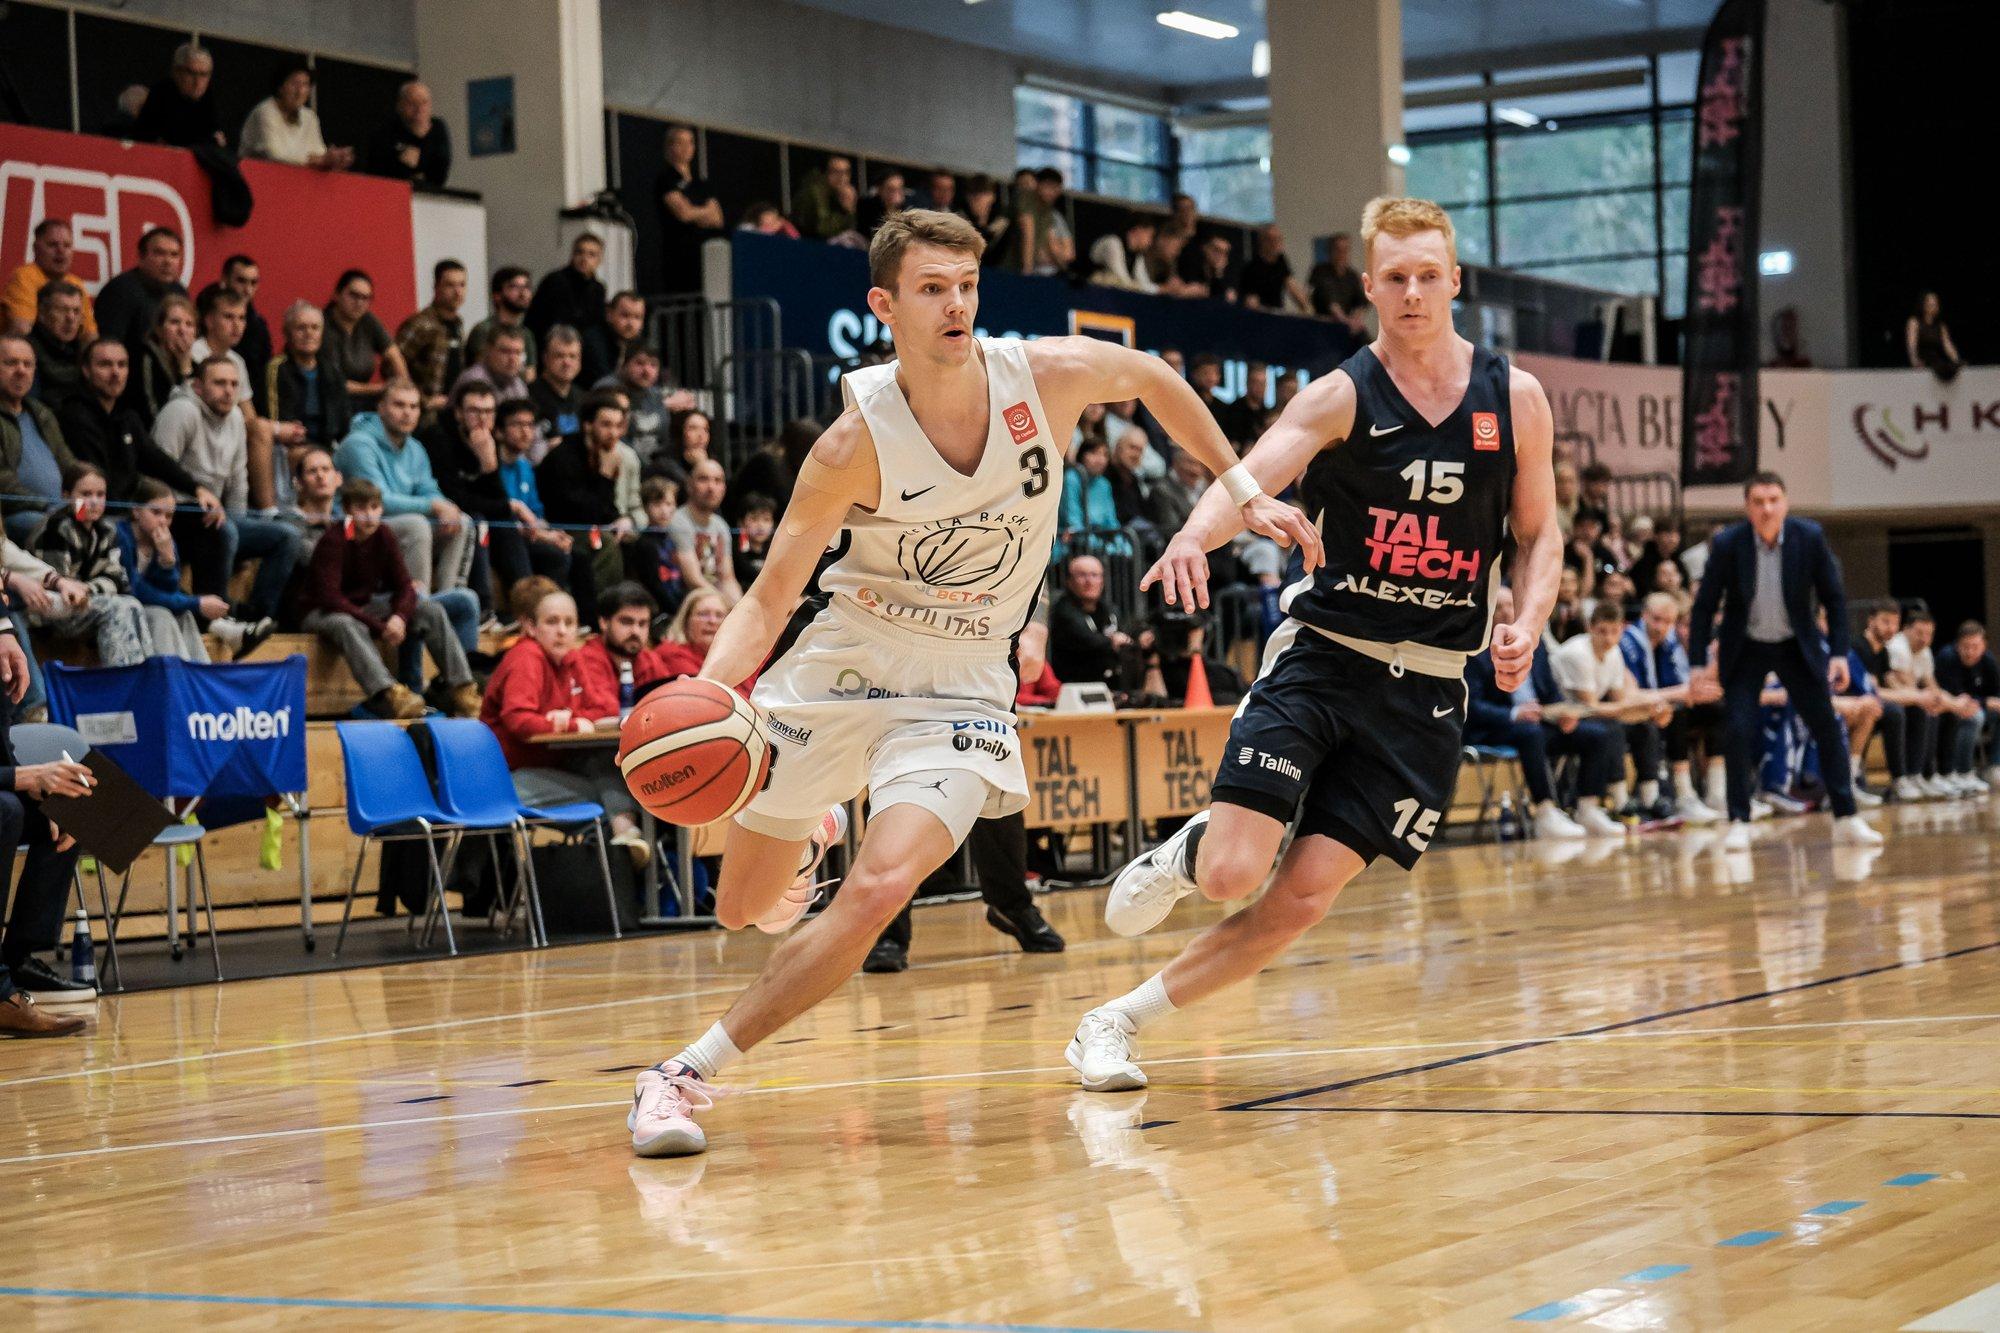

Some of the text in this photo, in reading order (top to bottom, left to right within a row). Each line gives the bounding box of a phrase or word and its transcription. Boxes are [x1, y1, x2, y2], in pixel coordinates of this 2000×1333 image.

[1018, 444, 1049, 500] 3
[1400, 459, 1465, 504] 15
[1368, 506, 1448, 550] TAL
[1365, 537, 1480, 582] TECH
[188, 706, 289, 741] molten
[975, 738, 1011, 762] Daily
[1033, 735, 1077, 776] TAL
[1163, 729, 1202, 768] TAL
[1258, 751, 1302, 782] Tallinn
[641, 764, 696, 797] molten
[1035, 776, 1099, 820] TECH
[1391, 797, 1442, 852] 15
